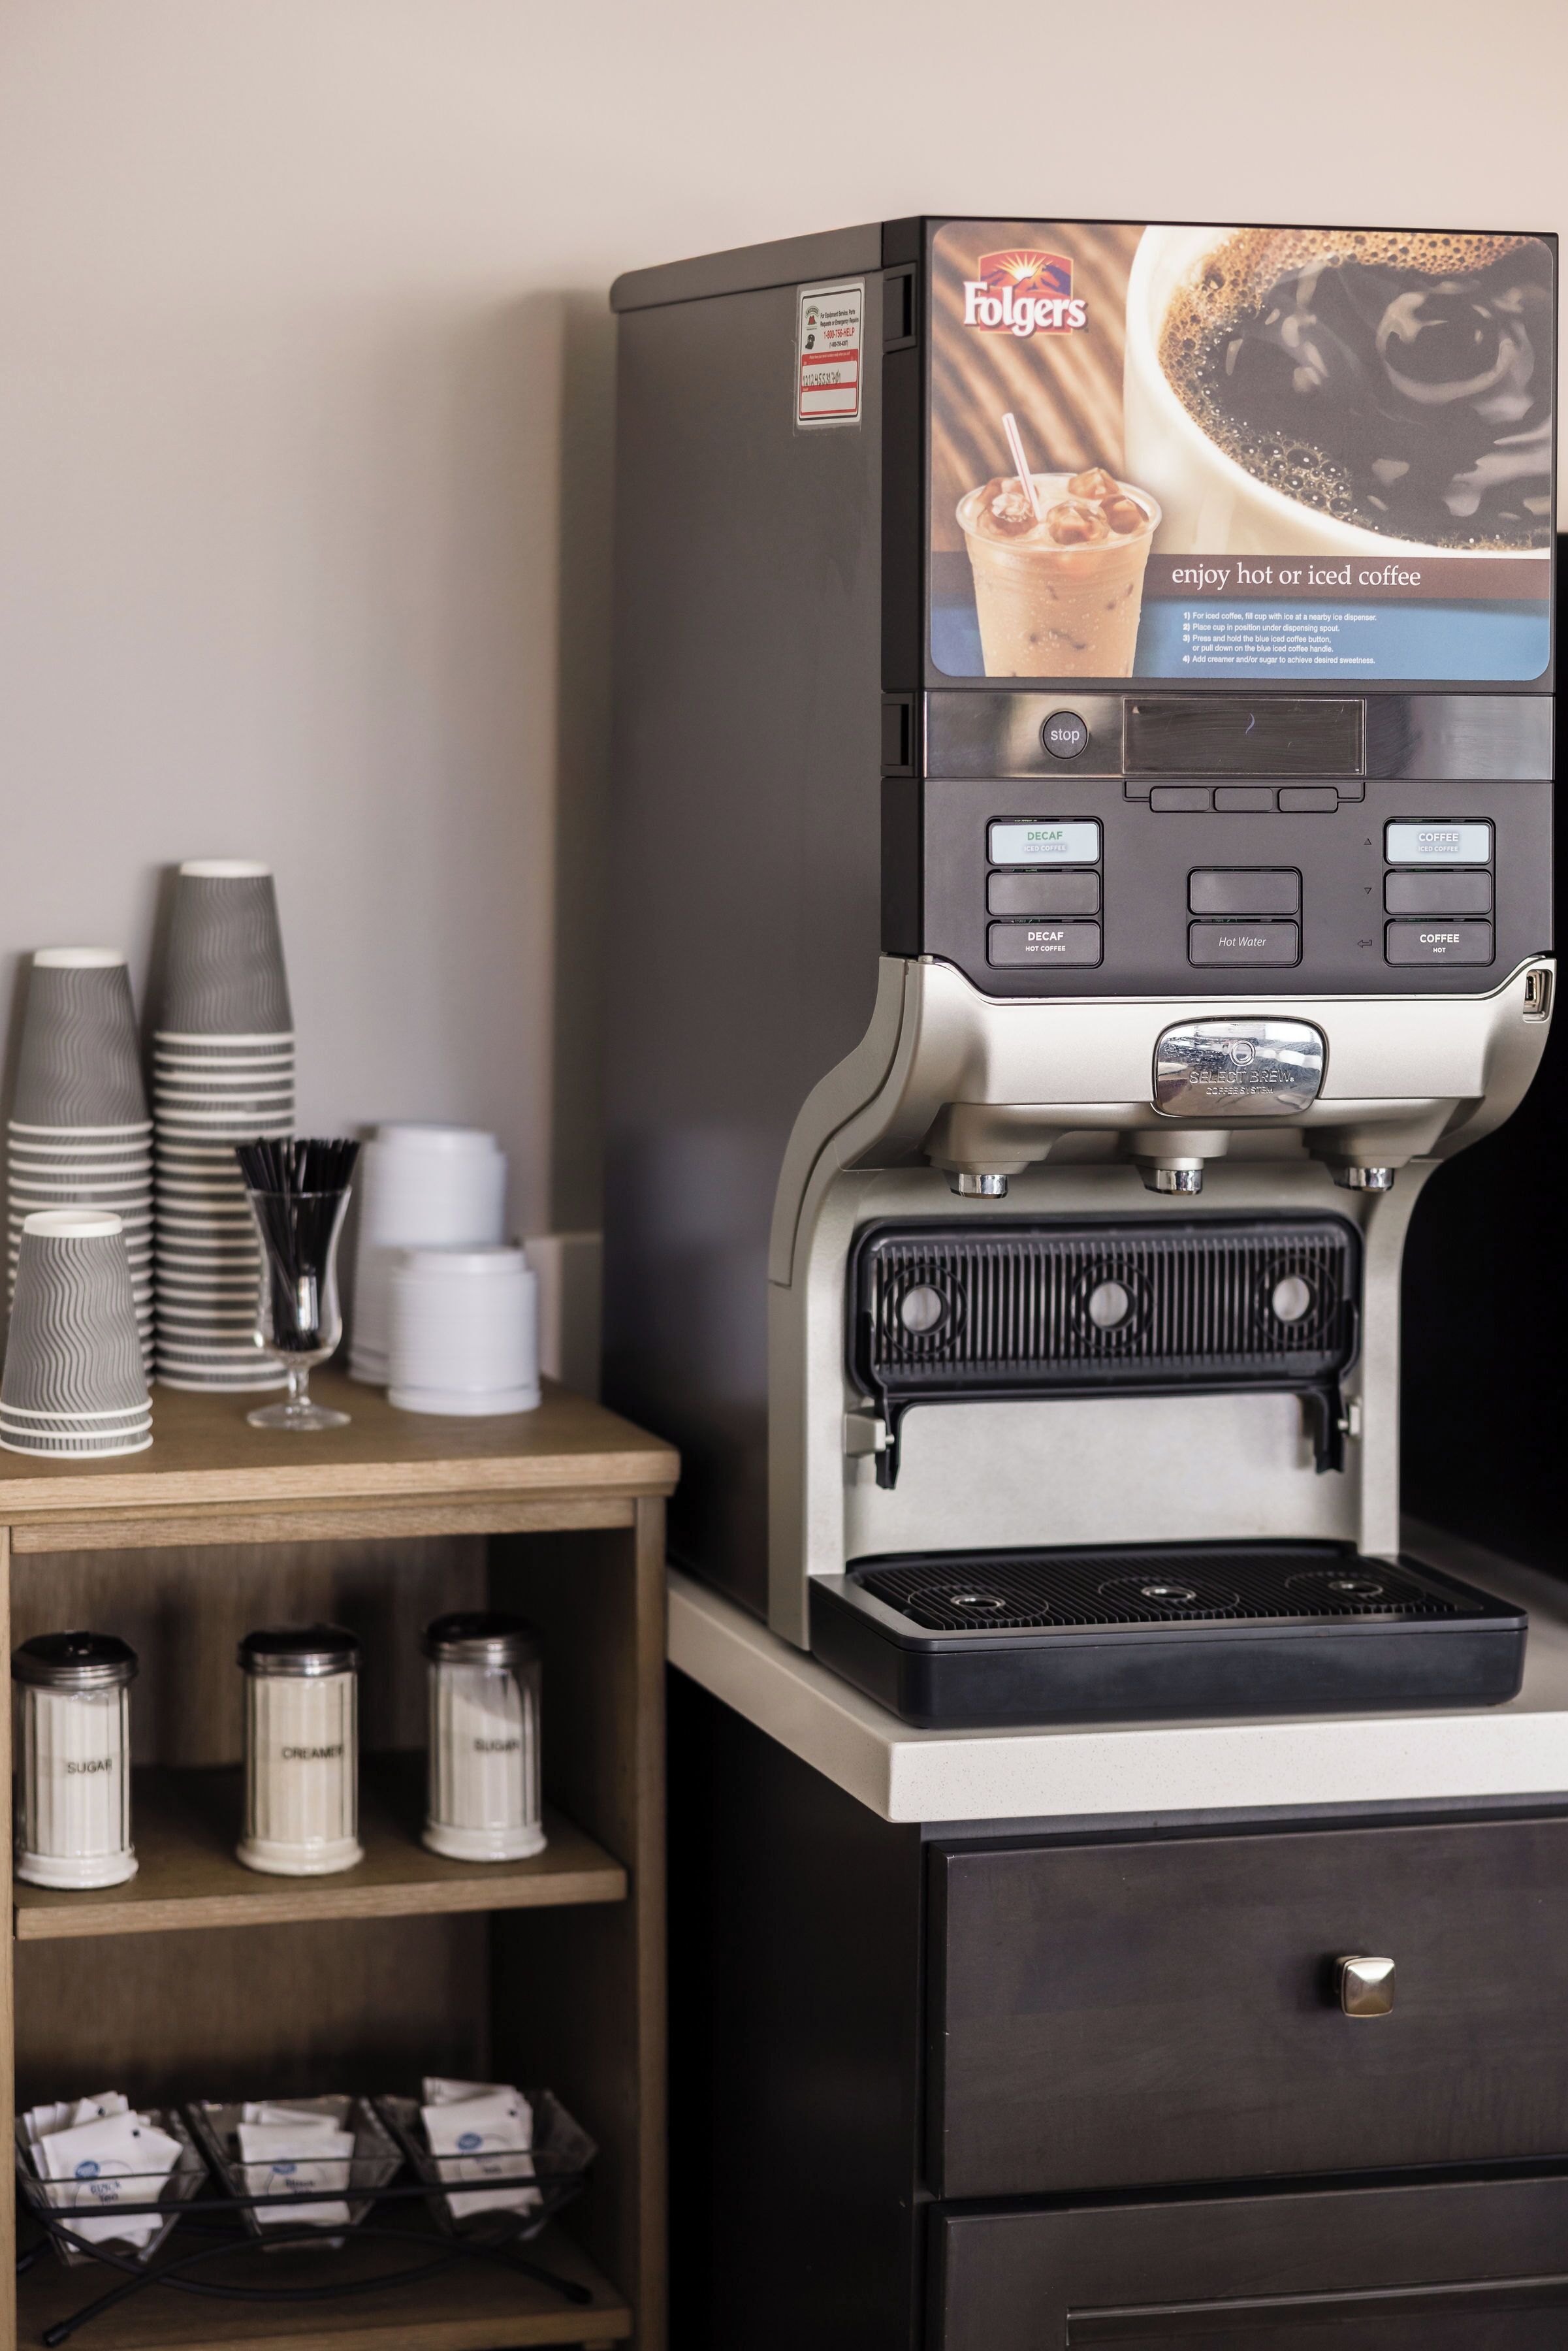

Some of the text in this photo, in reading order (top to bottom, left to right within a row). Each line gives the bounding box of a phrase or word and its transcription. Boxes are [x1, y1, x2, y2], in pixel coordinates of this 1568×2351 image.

[963, 281, 1087, 337] Folgers
[1172, 562, 1421, 590] enjoy hot or iced coffee
[1183, 612, 1191, 620] 1)
[1221, 612, 1243, 620] coffee,
[1309, 613, 1331, 622] nearby
[1344, 613, 1377, 622] dispenser.
[1183, 622, 1191, 632] 2)
[1234, 623, 1260, 632] position
[1283, 624, 1318, 633] dispensing
[1183, 634, 1190, 643] 3)
[1201, 644, 1213, 652] pull
[1182, 655, 1190, 664] 4)
[1050, 729, 1080, 744] stop
[1027, 831, 1063, 840] DECAF
[1418, 833, 1458, 842] COFFEE
[1028, 932, 1064, 941] DECAF
[1219, 936, 1266, 946] Hot Water
[1420, 934, 1460, 943] COFFEE
[1189, 1070, 1247, 1084] SELECT
[1206, 1086, 1273, 1095] COFFEE SYSTEM
